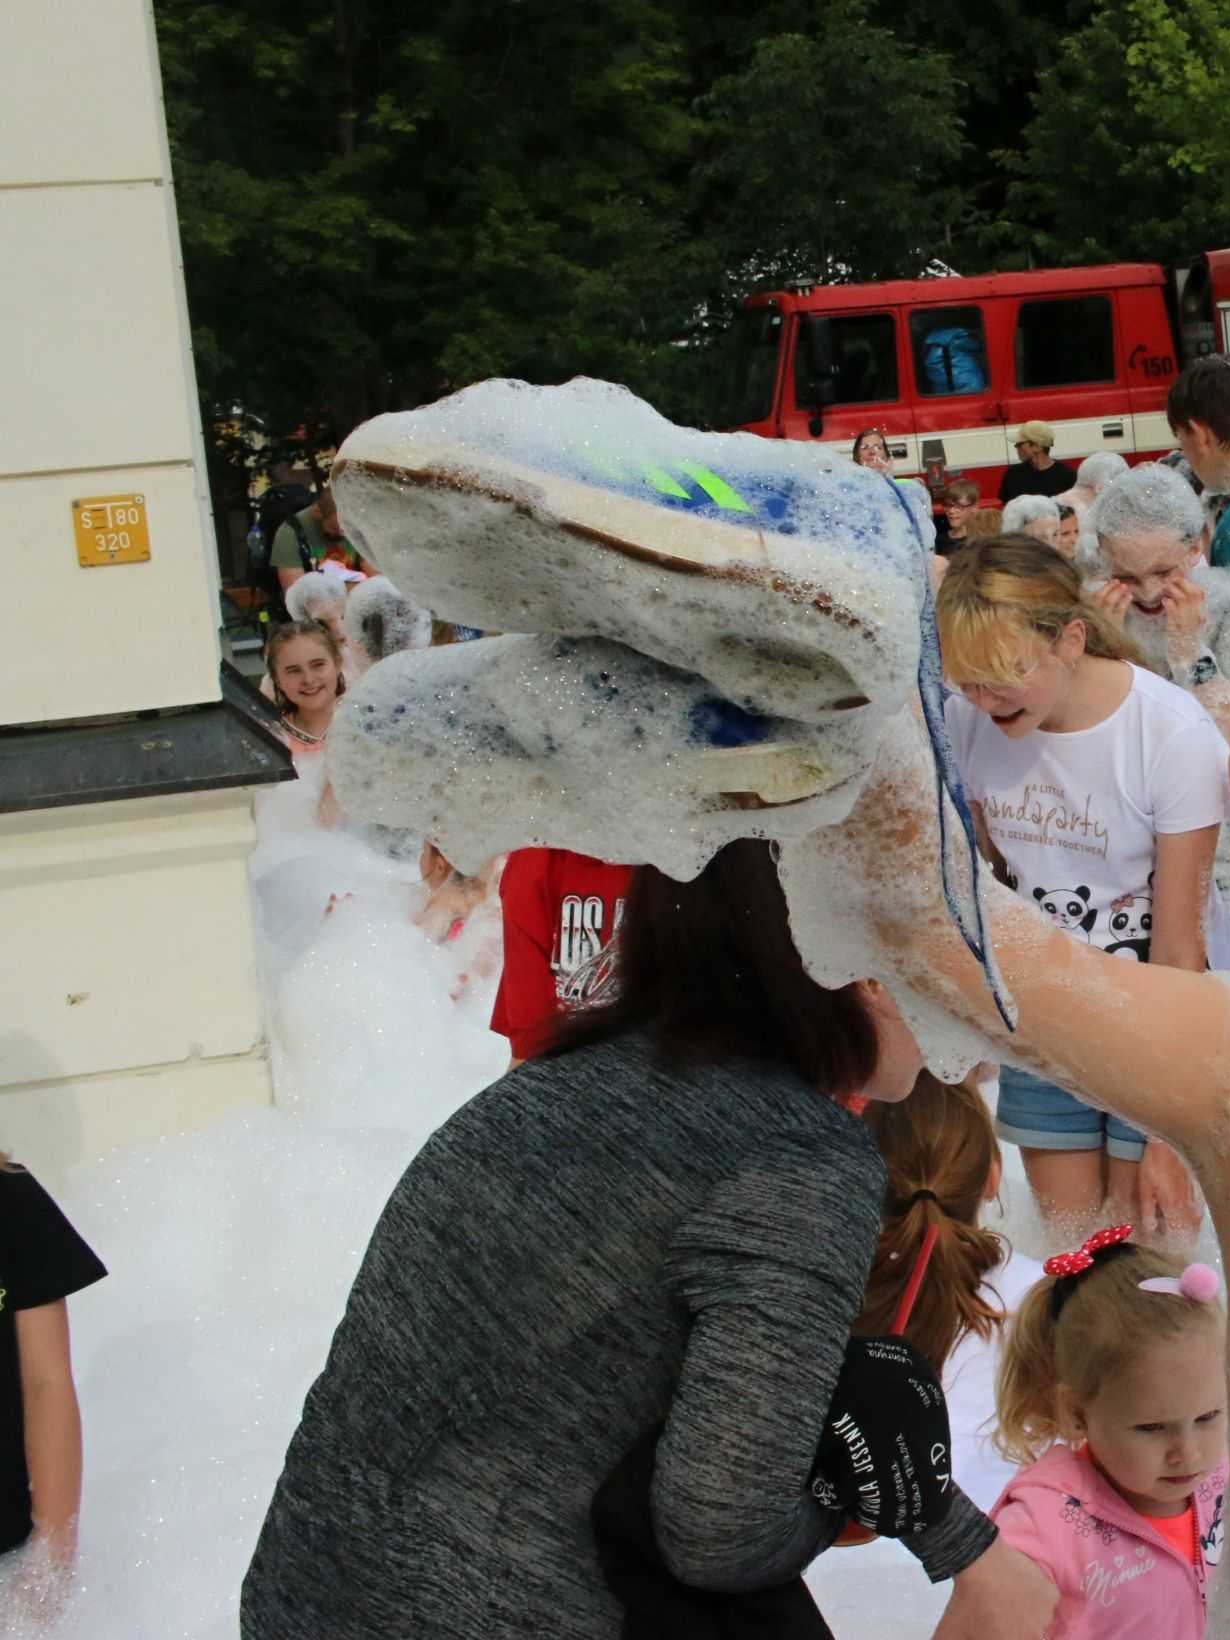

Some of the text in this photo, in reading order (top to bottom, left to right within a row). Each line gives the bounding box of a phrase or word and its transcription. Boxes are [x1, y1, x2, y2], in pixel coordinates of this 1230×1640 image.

[1142, 354, 1173, 378] 150
[81, 507, 139, 529] S 80
[95, 531, 130, 552] 320
[983, 785, 1109, 861] andaparty
[832, 1412, 875, 1474] JESENÍK
[1080, 1547, 1158, 1609] Minnie
